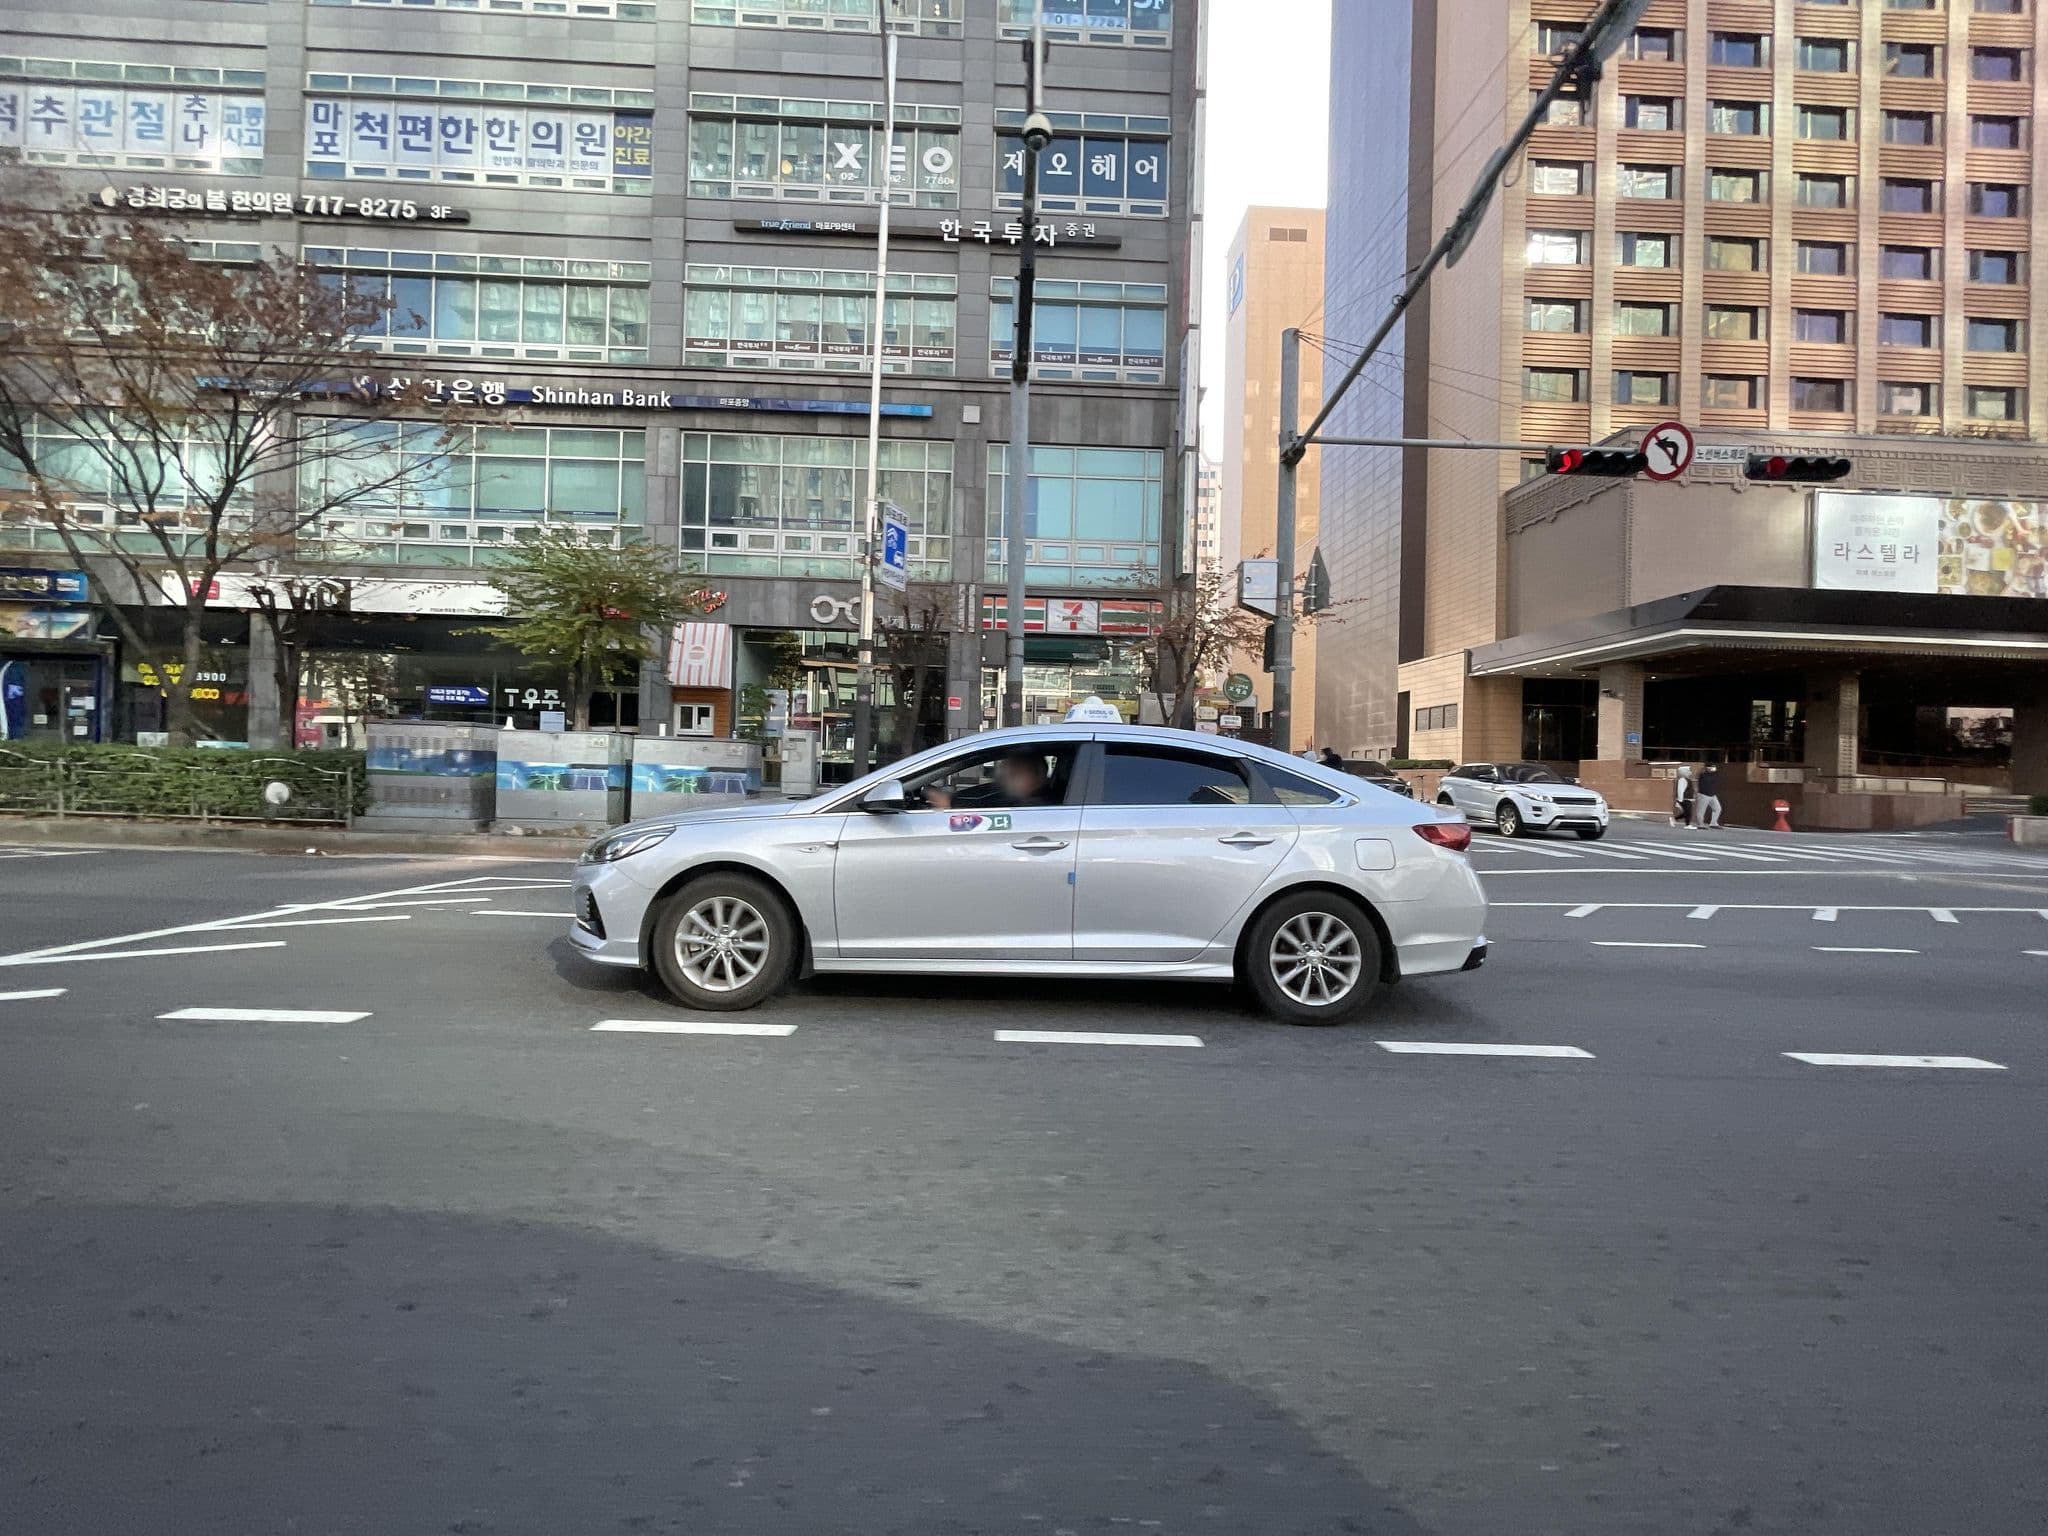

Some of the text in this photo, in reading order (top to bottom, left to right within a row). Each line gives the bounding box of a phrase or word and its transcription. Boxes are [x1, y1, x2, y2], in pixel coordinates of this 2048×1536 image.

[312, 103, 342, 155] 마포
[615, 126, 650, 144] 야간
[615, 147, 650, 165] 진료
[1003, 150, 1158, 183] 제오헤어
[231, 190, 294, 214] 한의원
[302, 194, 418, 220] 717-8275
[430, 205, 452, 219] 3F
[531, 385, 614, 405] Shinhan
[622, 388, 671, 407] Bank
[1833, 541, 1920, 564] 라스텔라
